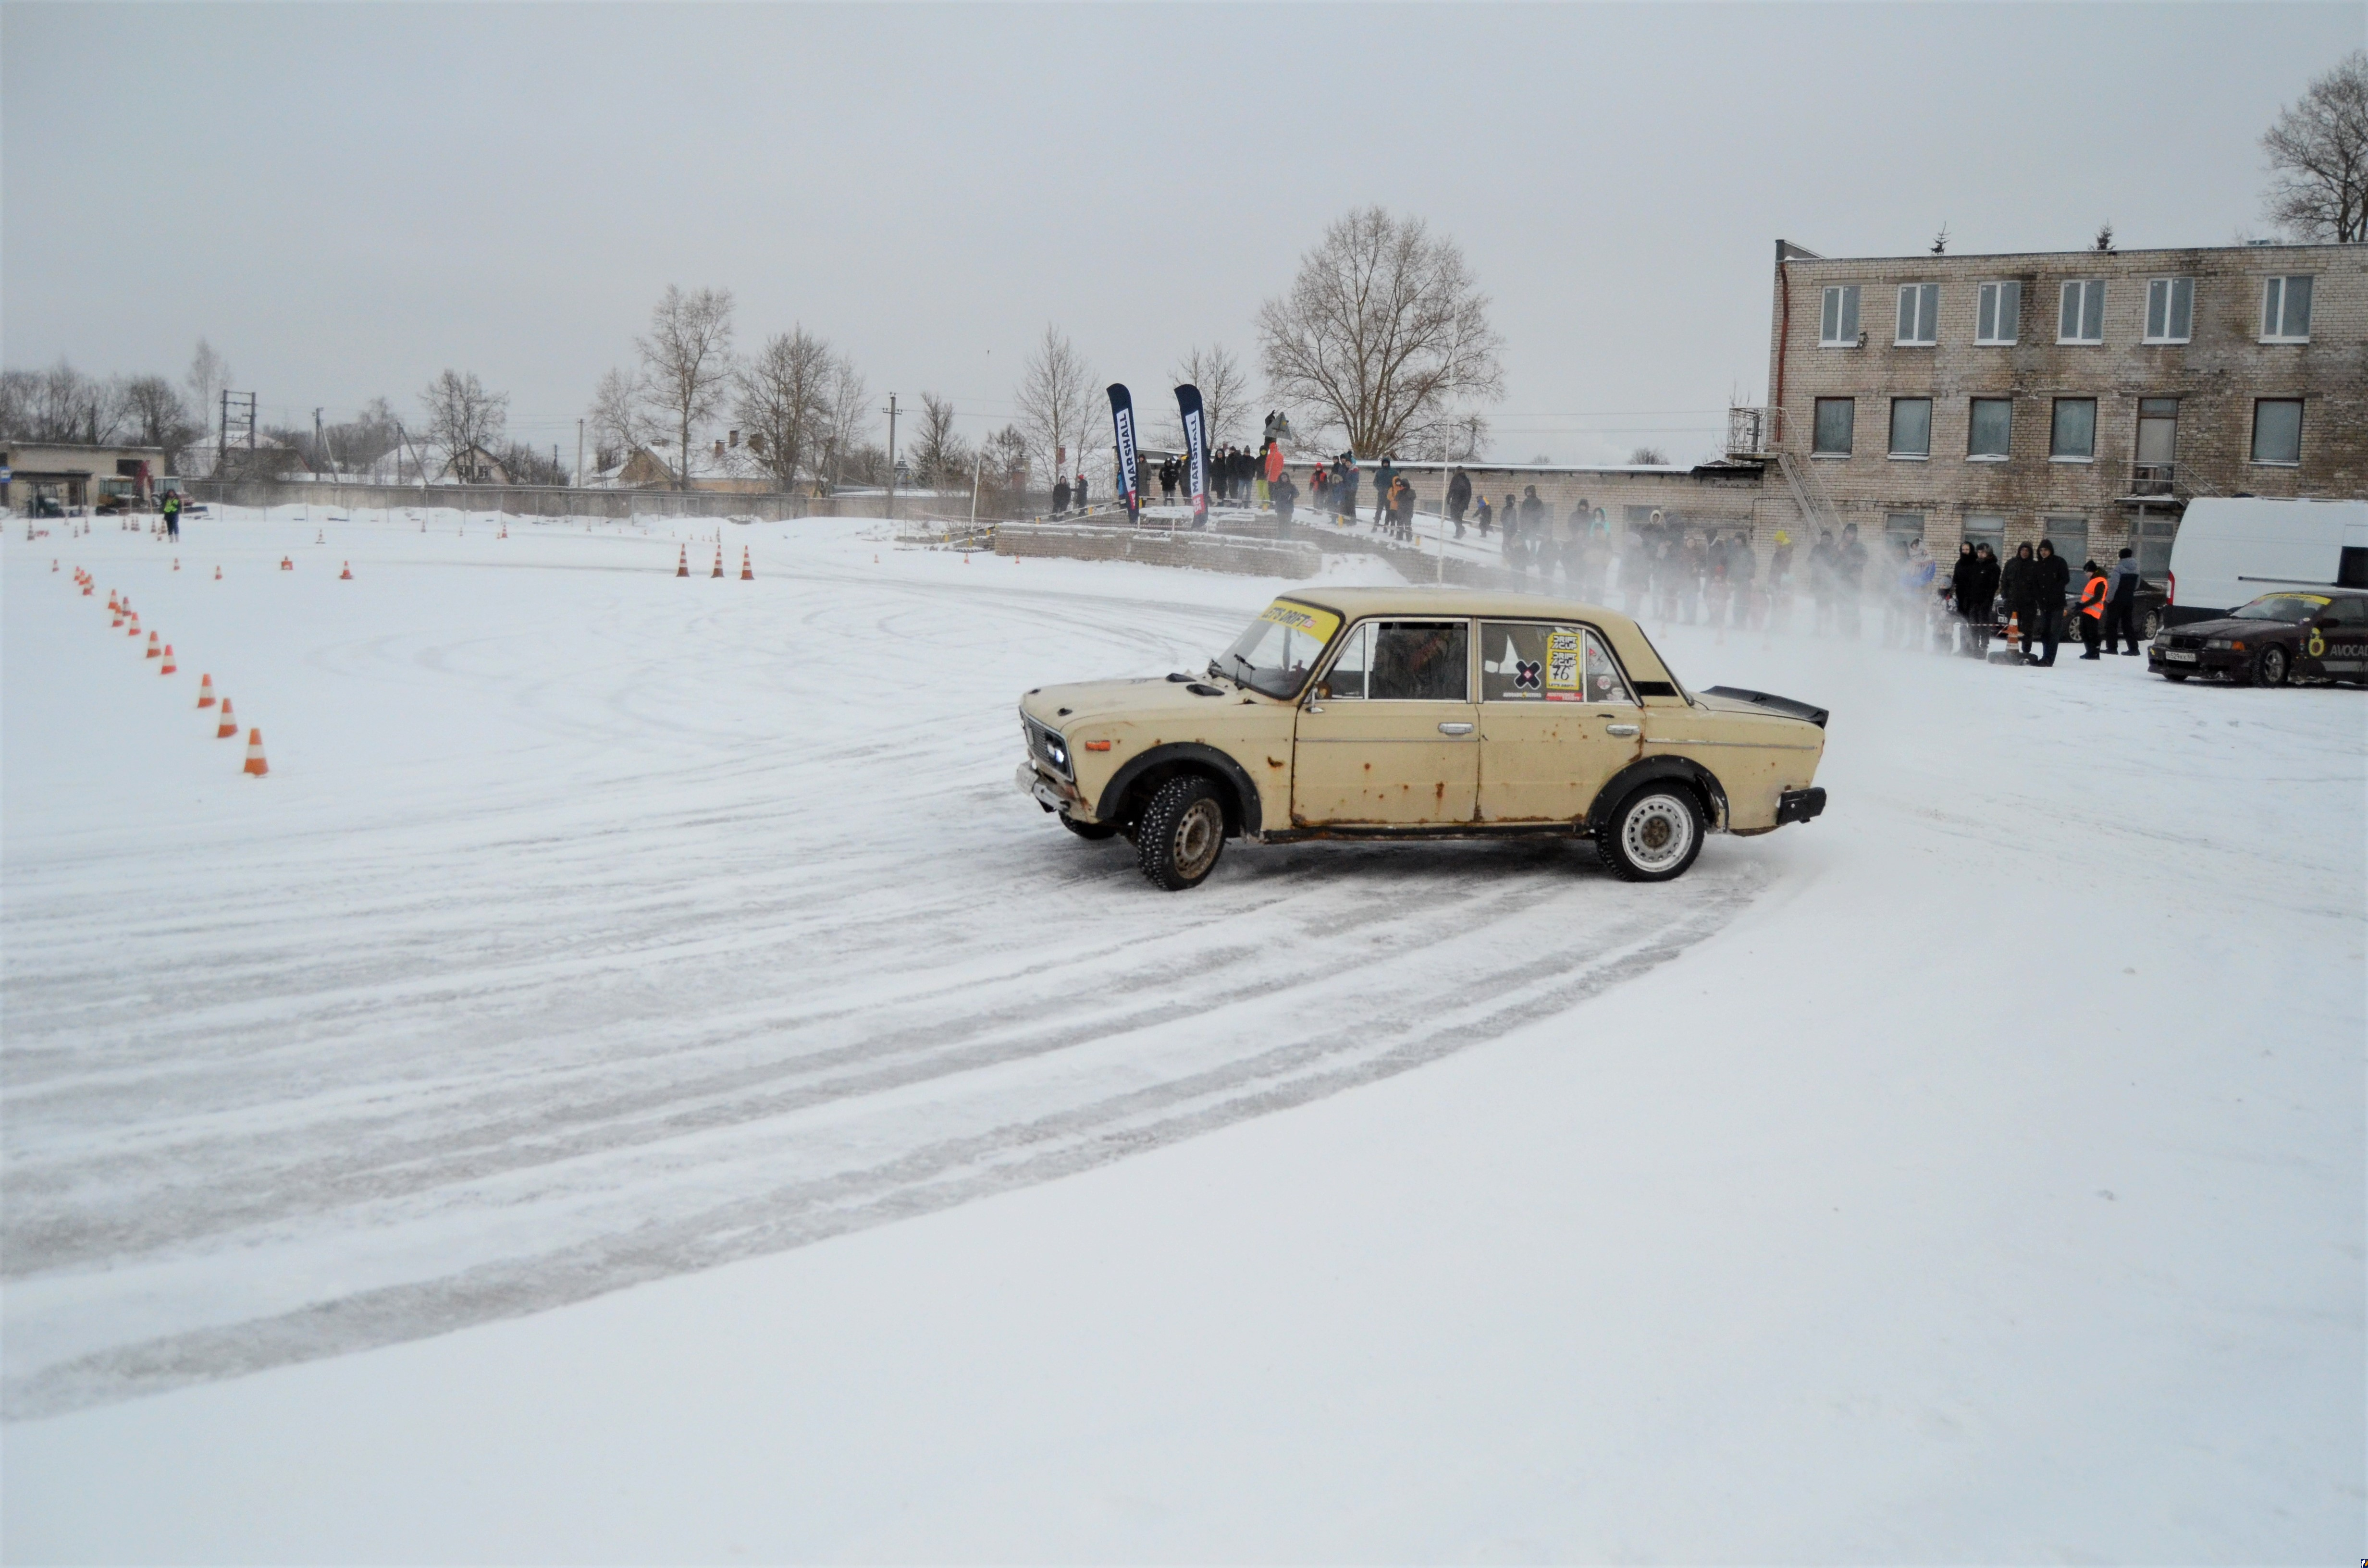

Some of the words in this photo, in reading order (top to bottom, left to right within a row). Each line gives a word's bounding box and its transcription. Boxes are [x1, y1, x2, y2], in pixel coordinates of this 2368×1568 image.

[1119, 412, 1136, 488] MARSHALL
[1553, 635, 1578, 644] DRIFT
[1558, 642, 1578, 650] CUP
[1552, 652, 1577, 660] DRIFT
[1557, 659, 1577, 667] CUP
[1552, 665, 1570, 680] 76
